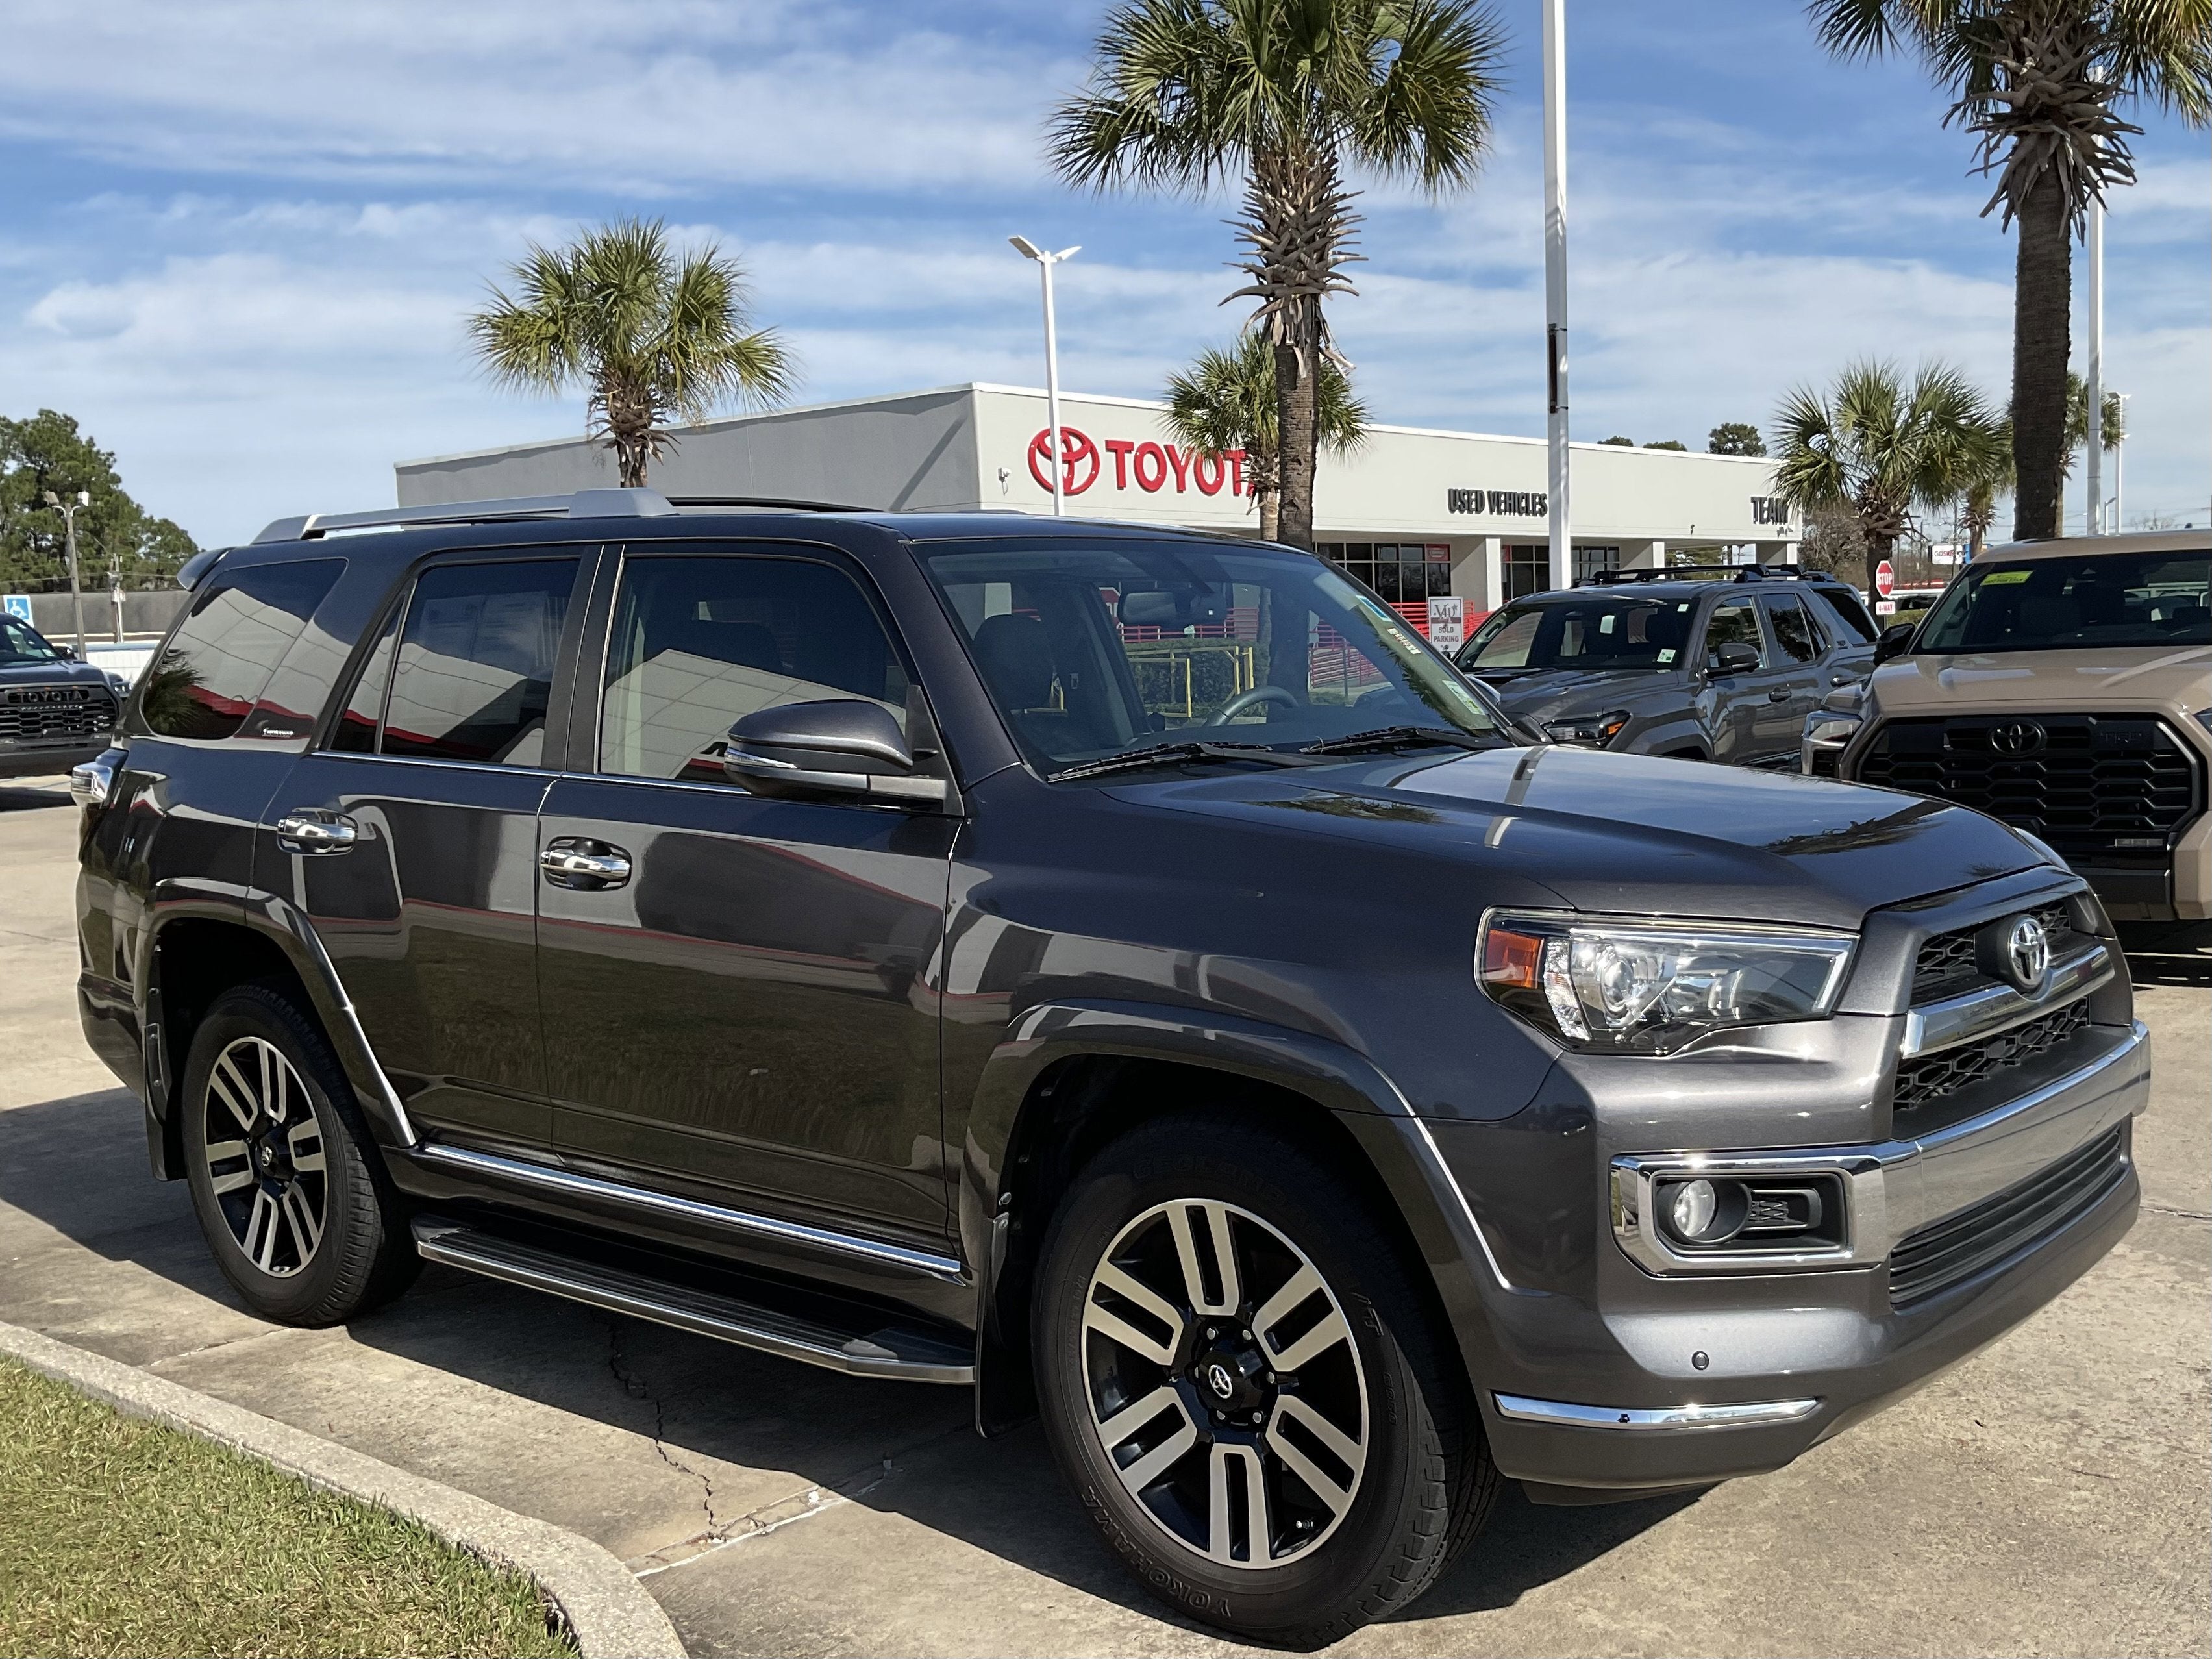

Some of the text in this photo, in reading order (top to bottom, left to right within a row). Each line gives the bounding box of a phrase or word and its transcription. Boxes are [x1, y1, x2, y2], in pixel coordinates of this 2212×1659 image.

[1448, 488, 1548, 517] USED VEHICLES
[1877, 573, 1893, 586] STOP
[1878, 603, 1893, 612] 4-WAY
[16, 690, 84, 703] TOYOTA
[1081, 1485, 1232, 1619] YOKOHAMA
